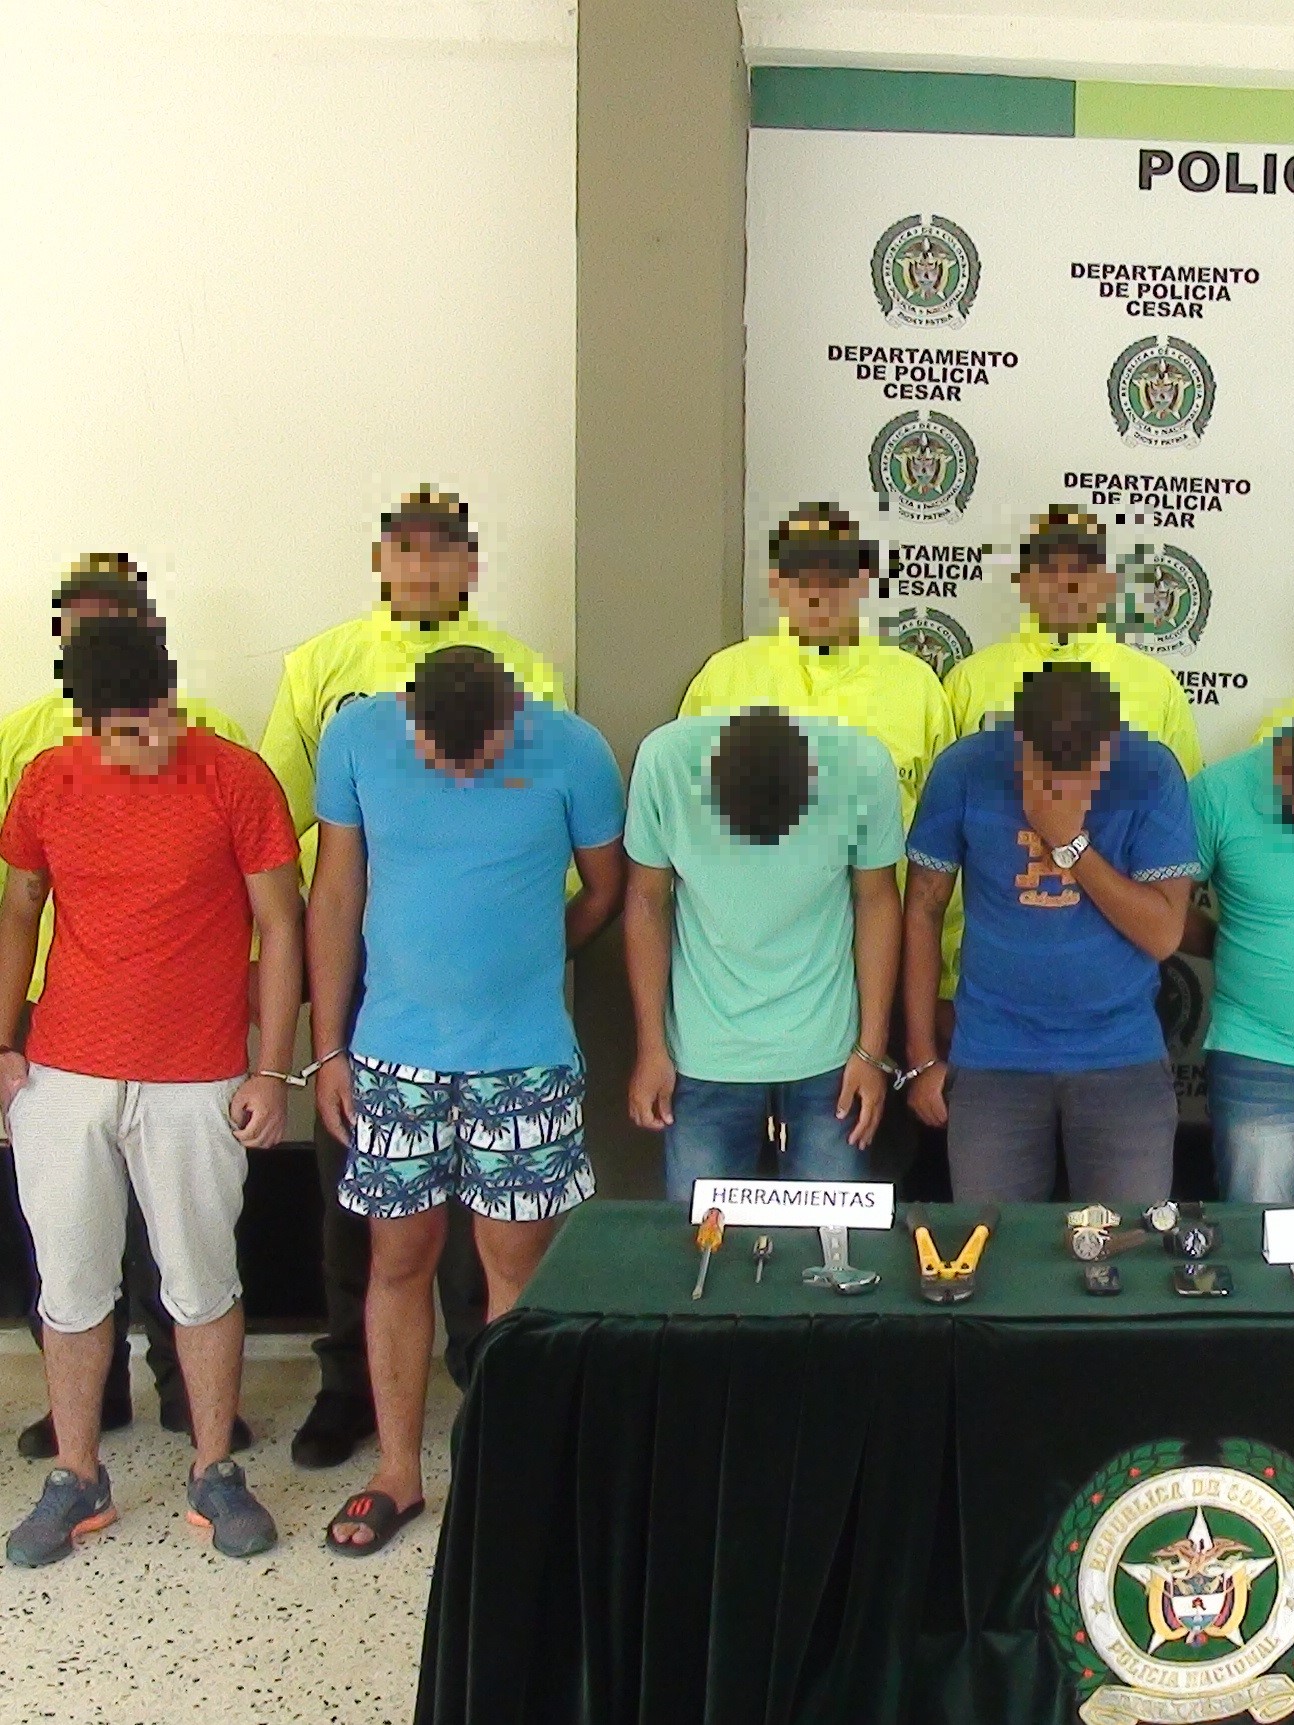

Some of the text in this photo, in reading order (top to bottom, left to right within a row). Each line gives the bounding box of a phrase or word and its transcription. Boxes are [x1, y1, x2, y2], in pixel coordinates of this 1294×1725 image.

[1071, 262, 1259, 284] DEPARTAMENTO
[1100, 282, 1231, 301] DE POLICIA
[1126, 300, 1203, 319] CESAR
[828, 345, 1018, 368] DEPARTAMENTO
[857, 364, 989, 385] DE POLICIA
[883, 383, 961, 401] CESAR
[1064, 472, 1250, 495] DEPARTAMENTO
[1092, 491, 1222, 512] DE POLICIA
[899, 580, 957, 598] ESAR
[712, 1187, 875, 1208] HERRAMIENTAS
